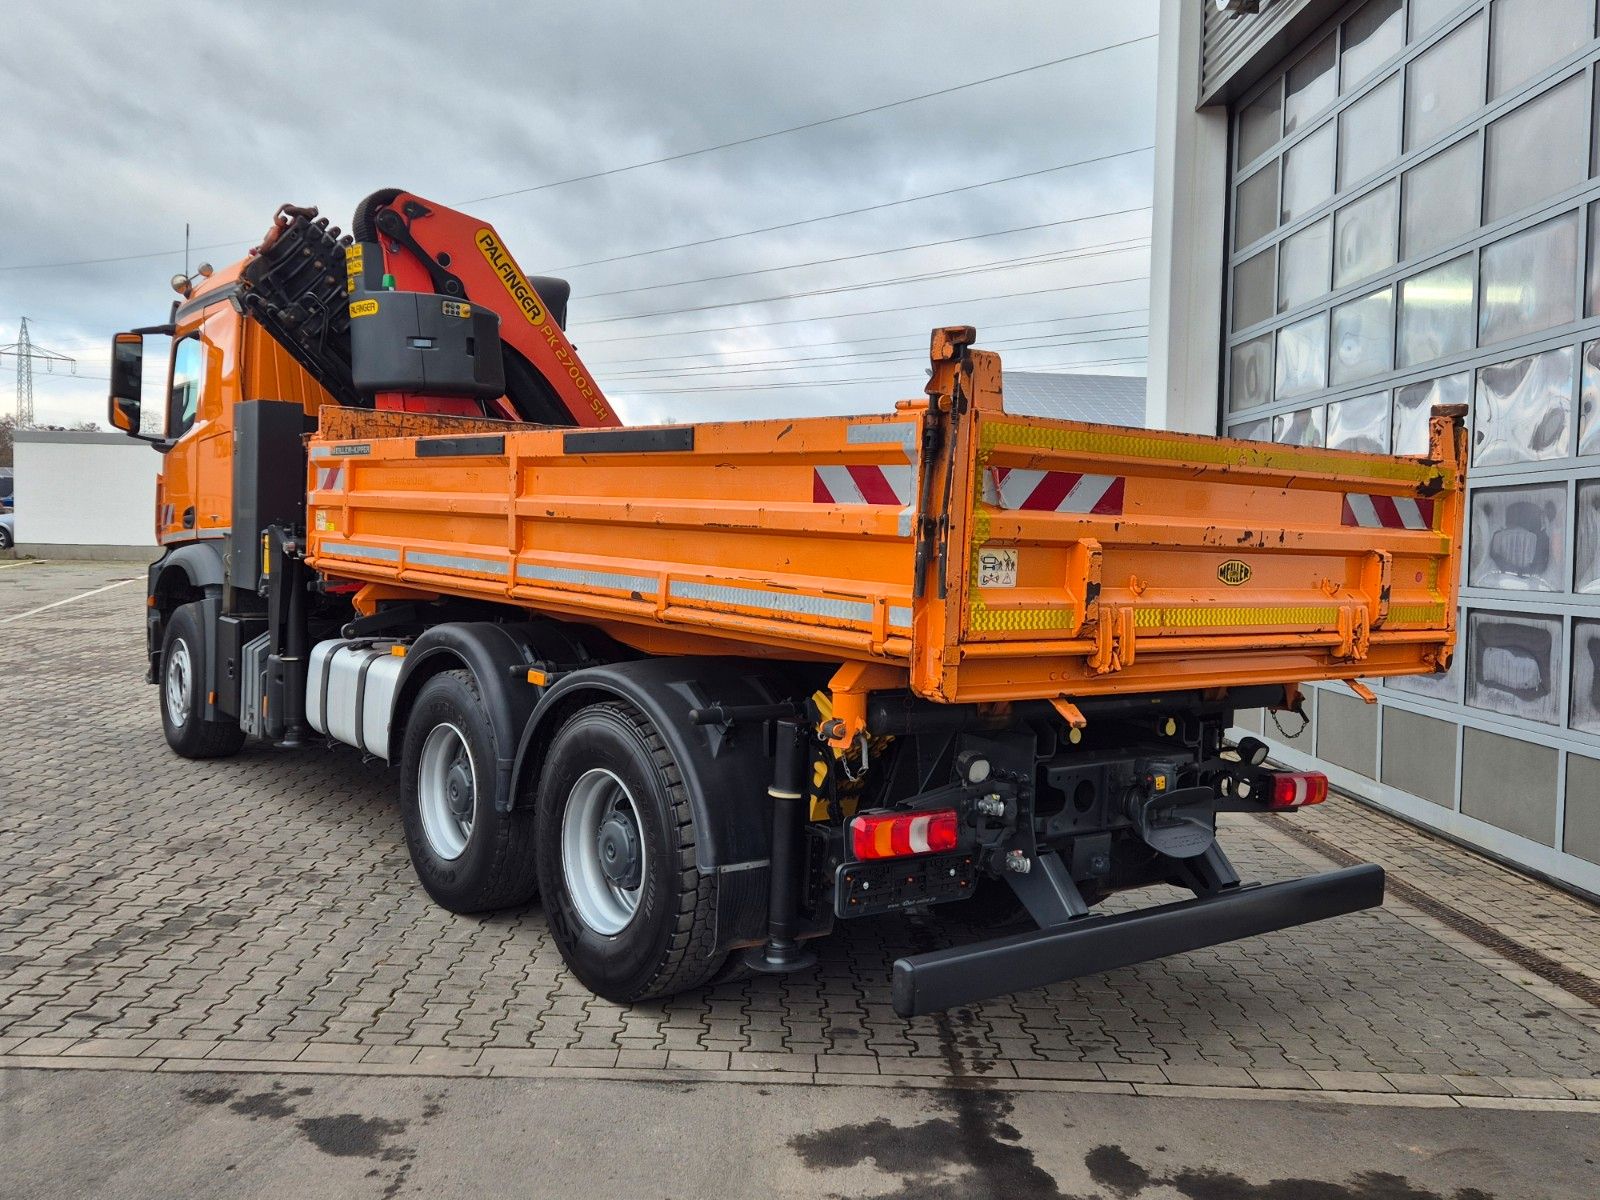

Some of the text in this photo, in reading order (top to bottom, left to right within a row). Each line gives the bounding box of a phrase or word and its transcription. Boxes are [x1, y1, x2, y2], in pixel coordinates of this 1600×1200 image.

[480, 234, 541, 320] PALFINGER
[541, 325, 558, 347] PK
[1219, 562, 1249, 583] MEILLER
